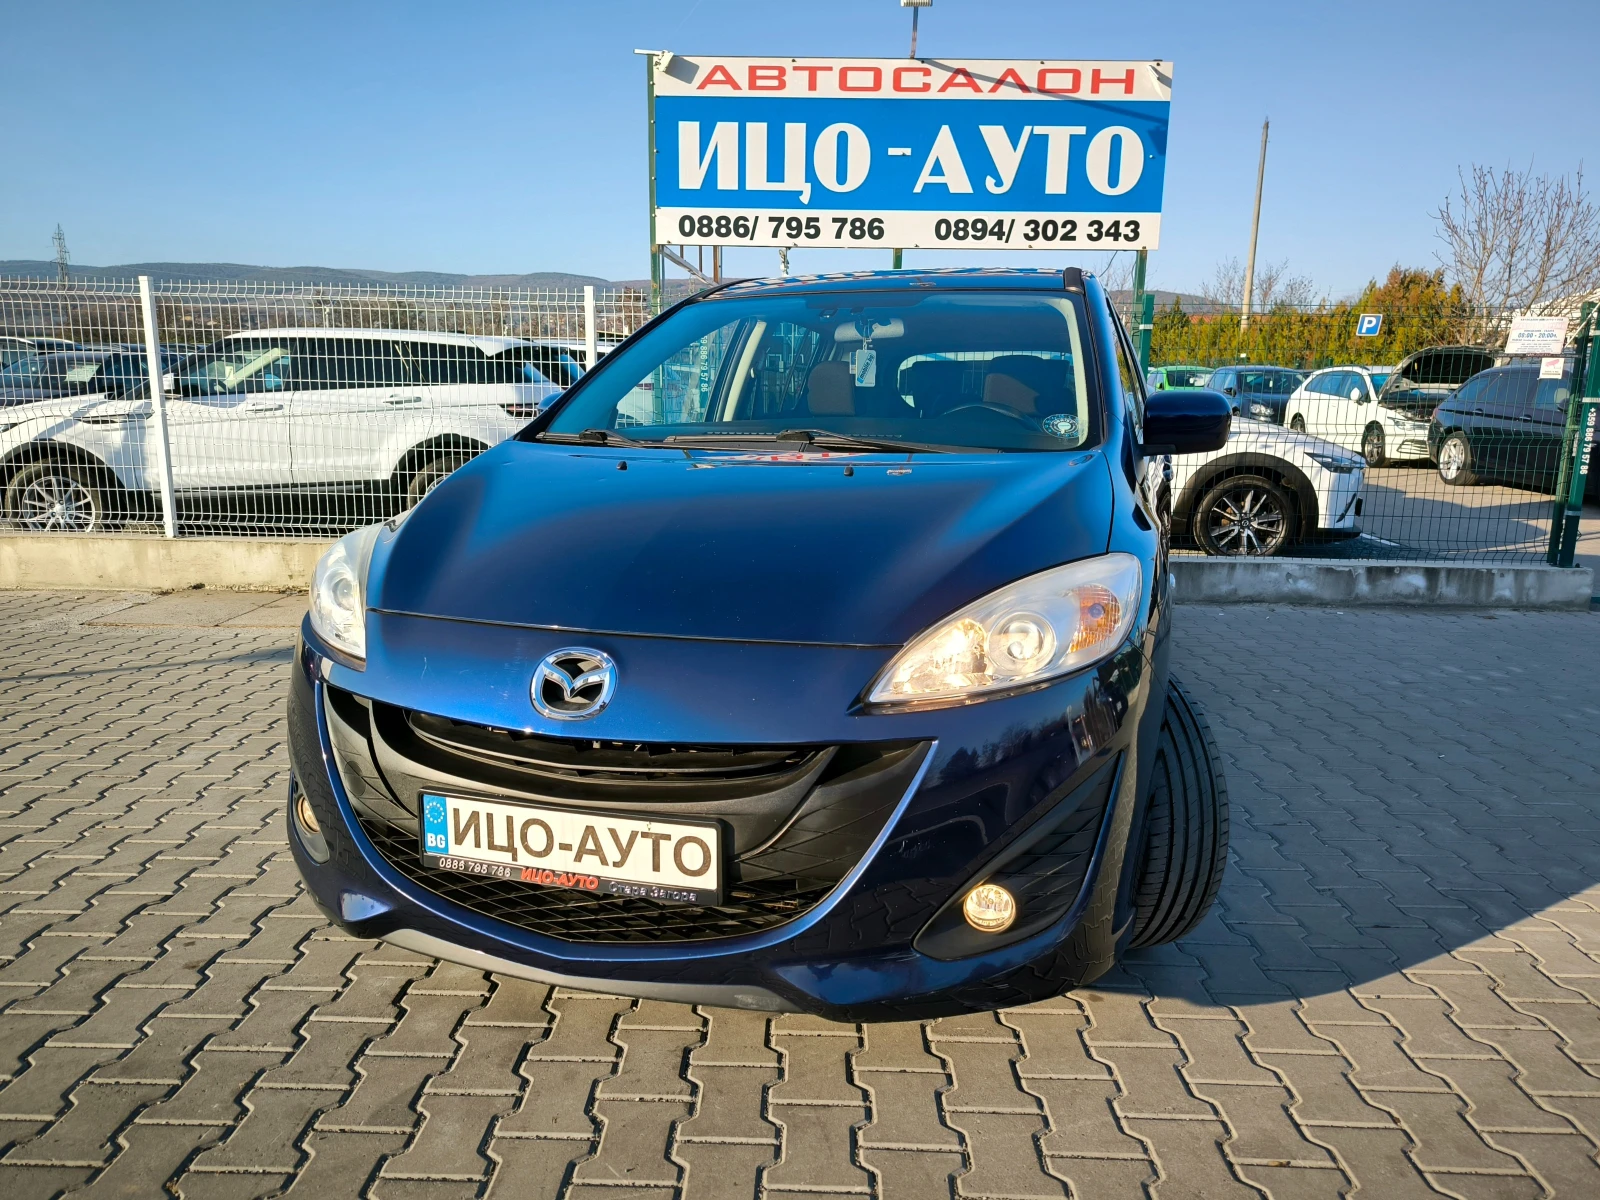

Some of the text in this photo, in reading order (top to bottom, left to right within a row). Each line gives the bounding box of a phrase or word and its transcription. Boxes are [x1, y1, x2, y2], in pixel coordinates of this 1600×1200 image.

[696, 64, 1135, 95] АВТОСАЛОН
[678, 215, 885, 241] 0886/ 795 786
[934, 218, 1141, 243] 0894/ 302 343
[1361, 317, 1378, 334] P
[1579, 407, 1596, 475] +359 886 79 57 86
[427, 833, 446, 849] BG
[452, 807, 712, 877] ИЦО-АУТО
[468, 862, 488, 874] 795
[491, 866, 511, 877] 786
[520, 867, 599, 890] ИЦО-АУТО
[608, 881, 698, 902] Стара Загора
